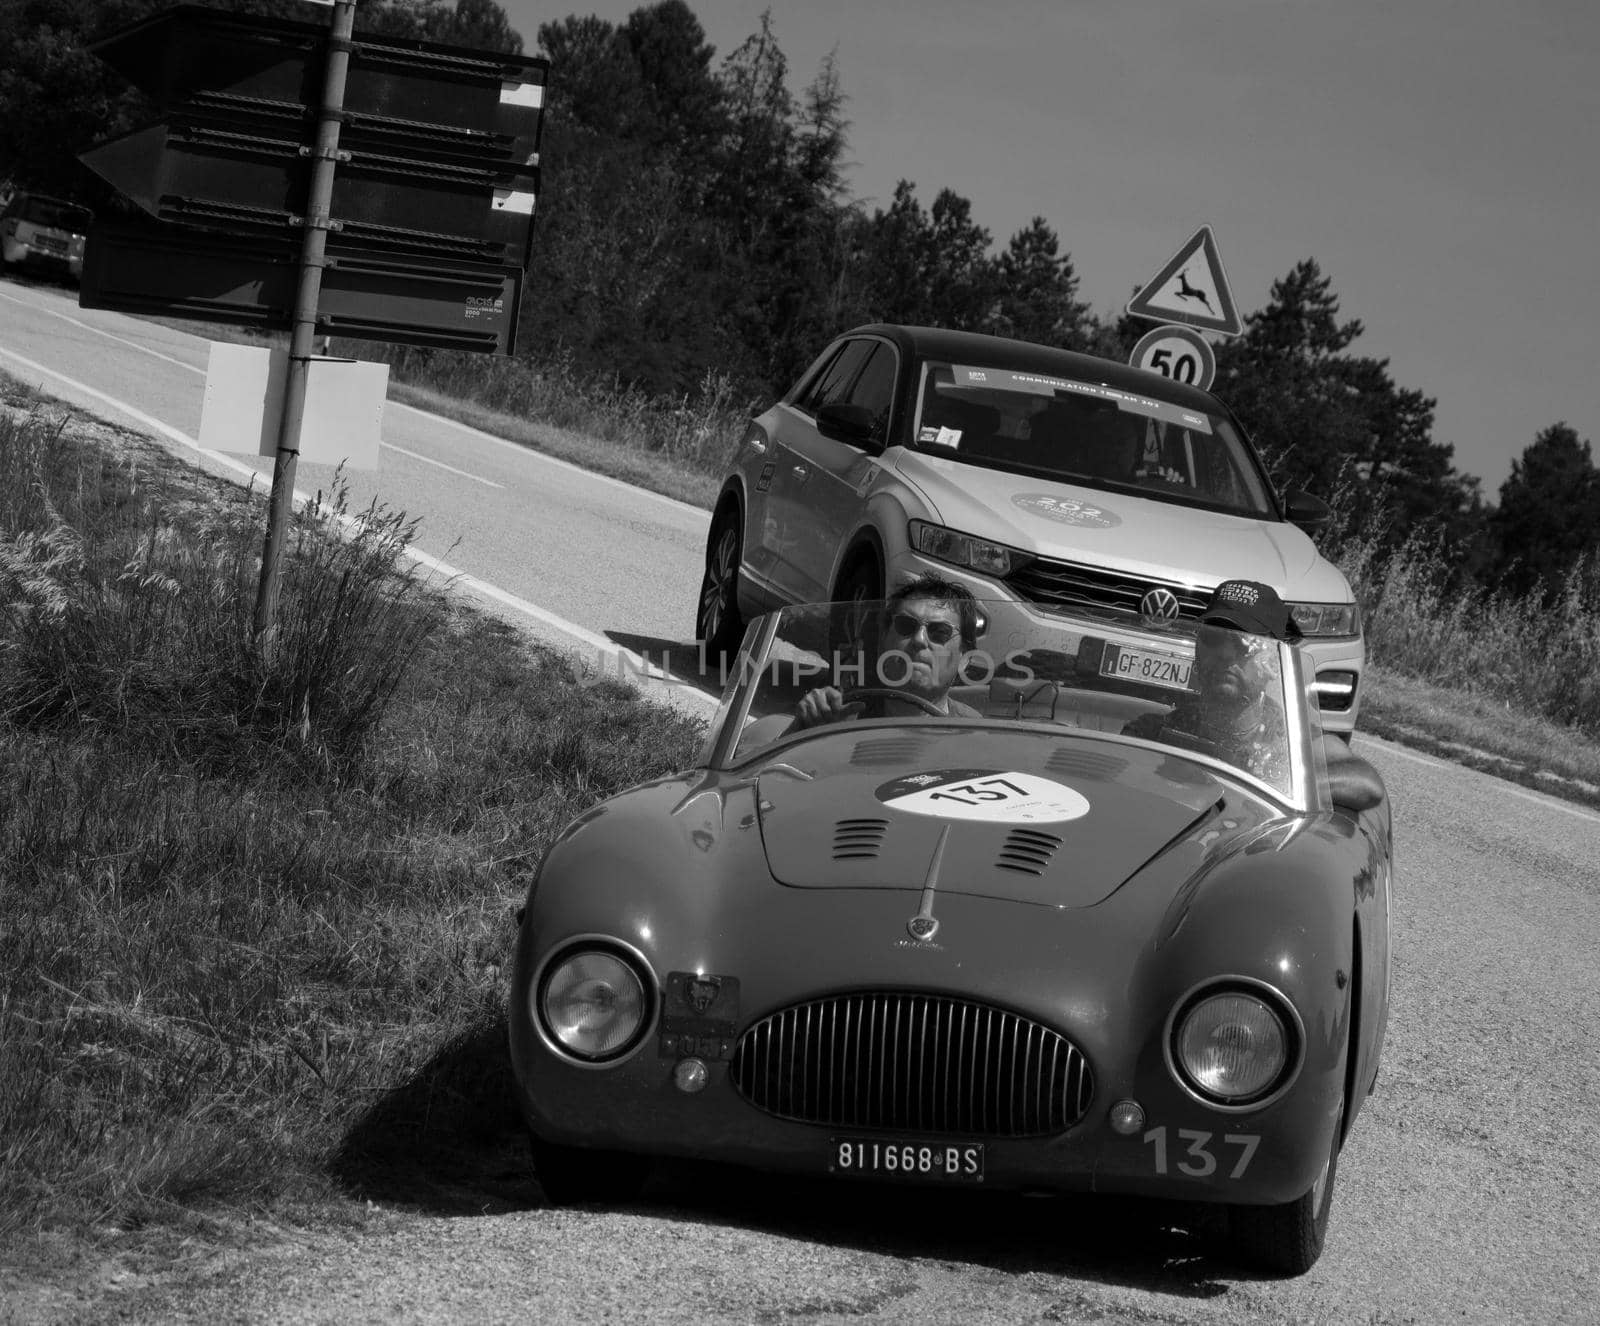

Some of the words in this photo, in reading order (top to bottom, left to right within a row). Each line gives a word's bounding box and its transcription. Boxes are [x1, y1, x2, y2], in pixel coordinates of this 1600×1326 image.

[1151, 349, 1196, 385] 50
[1012, 375, 1097, 393] COMMUNICATION
[1037, 497, 1101, 517] 202
[1119, 653, 1139, 673] GF
[1142, 658, 1190, 684] 822NJ
[929, 779, 1030, 806] 137
[839, 1143, 932, 1172] 811668
[946, 1148, 978, 1174] BS
[1143, 1126, 1261, 1179] 137
